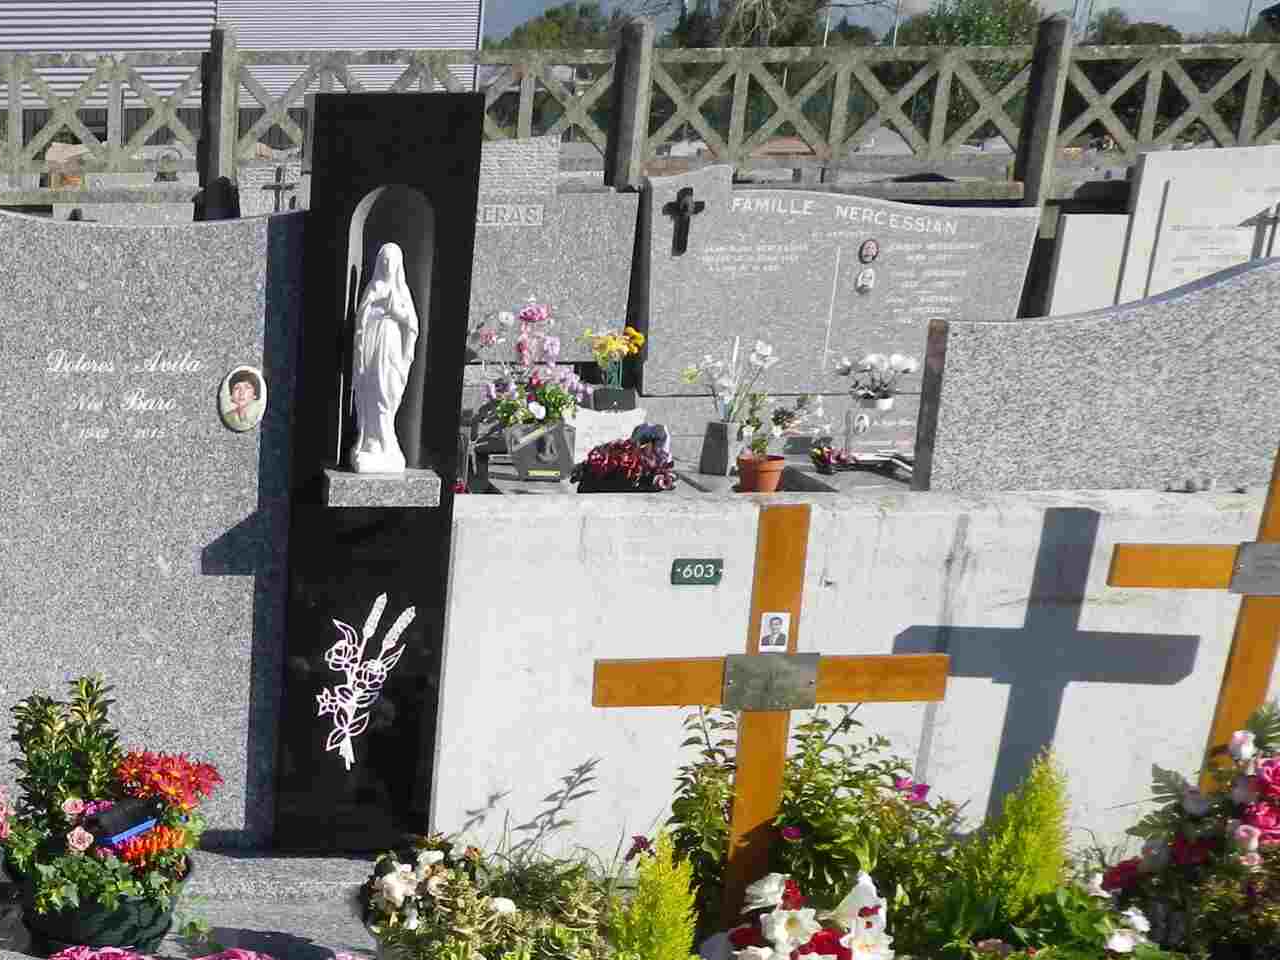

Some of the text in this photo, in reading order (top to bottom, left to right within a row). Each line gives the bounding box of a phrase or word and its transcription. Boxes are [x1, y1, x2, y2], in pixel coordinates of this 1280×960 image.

[731, 198, 959, 235] FAMILLE NERCESSIAN
[47, 349, 114, 373] Dolores
[682, 564, 714, 578] 603
